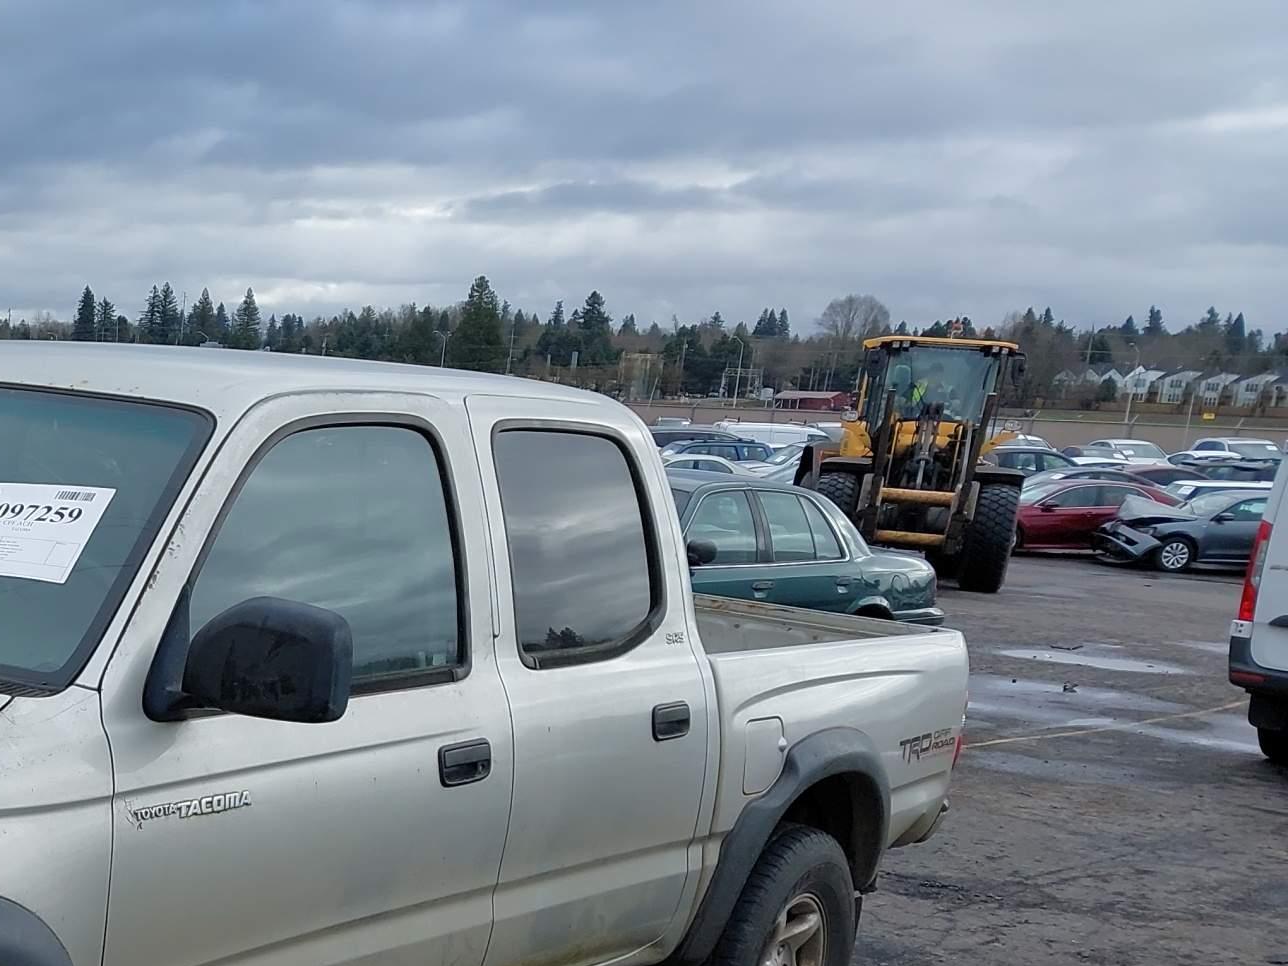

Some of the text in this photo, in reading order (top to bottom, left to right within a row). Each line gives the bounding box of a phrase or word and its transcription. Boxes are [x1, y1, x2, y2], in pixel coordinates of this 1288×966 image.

[899, 732, 932, 765] TRD
[135, 789, 252, 821] TOYOTA TACOMA
